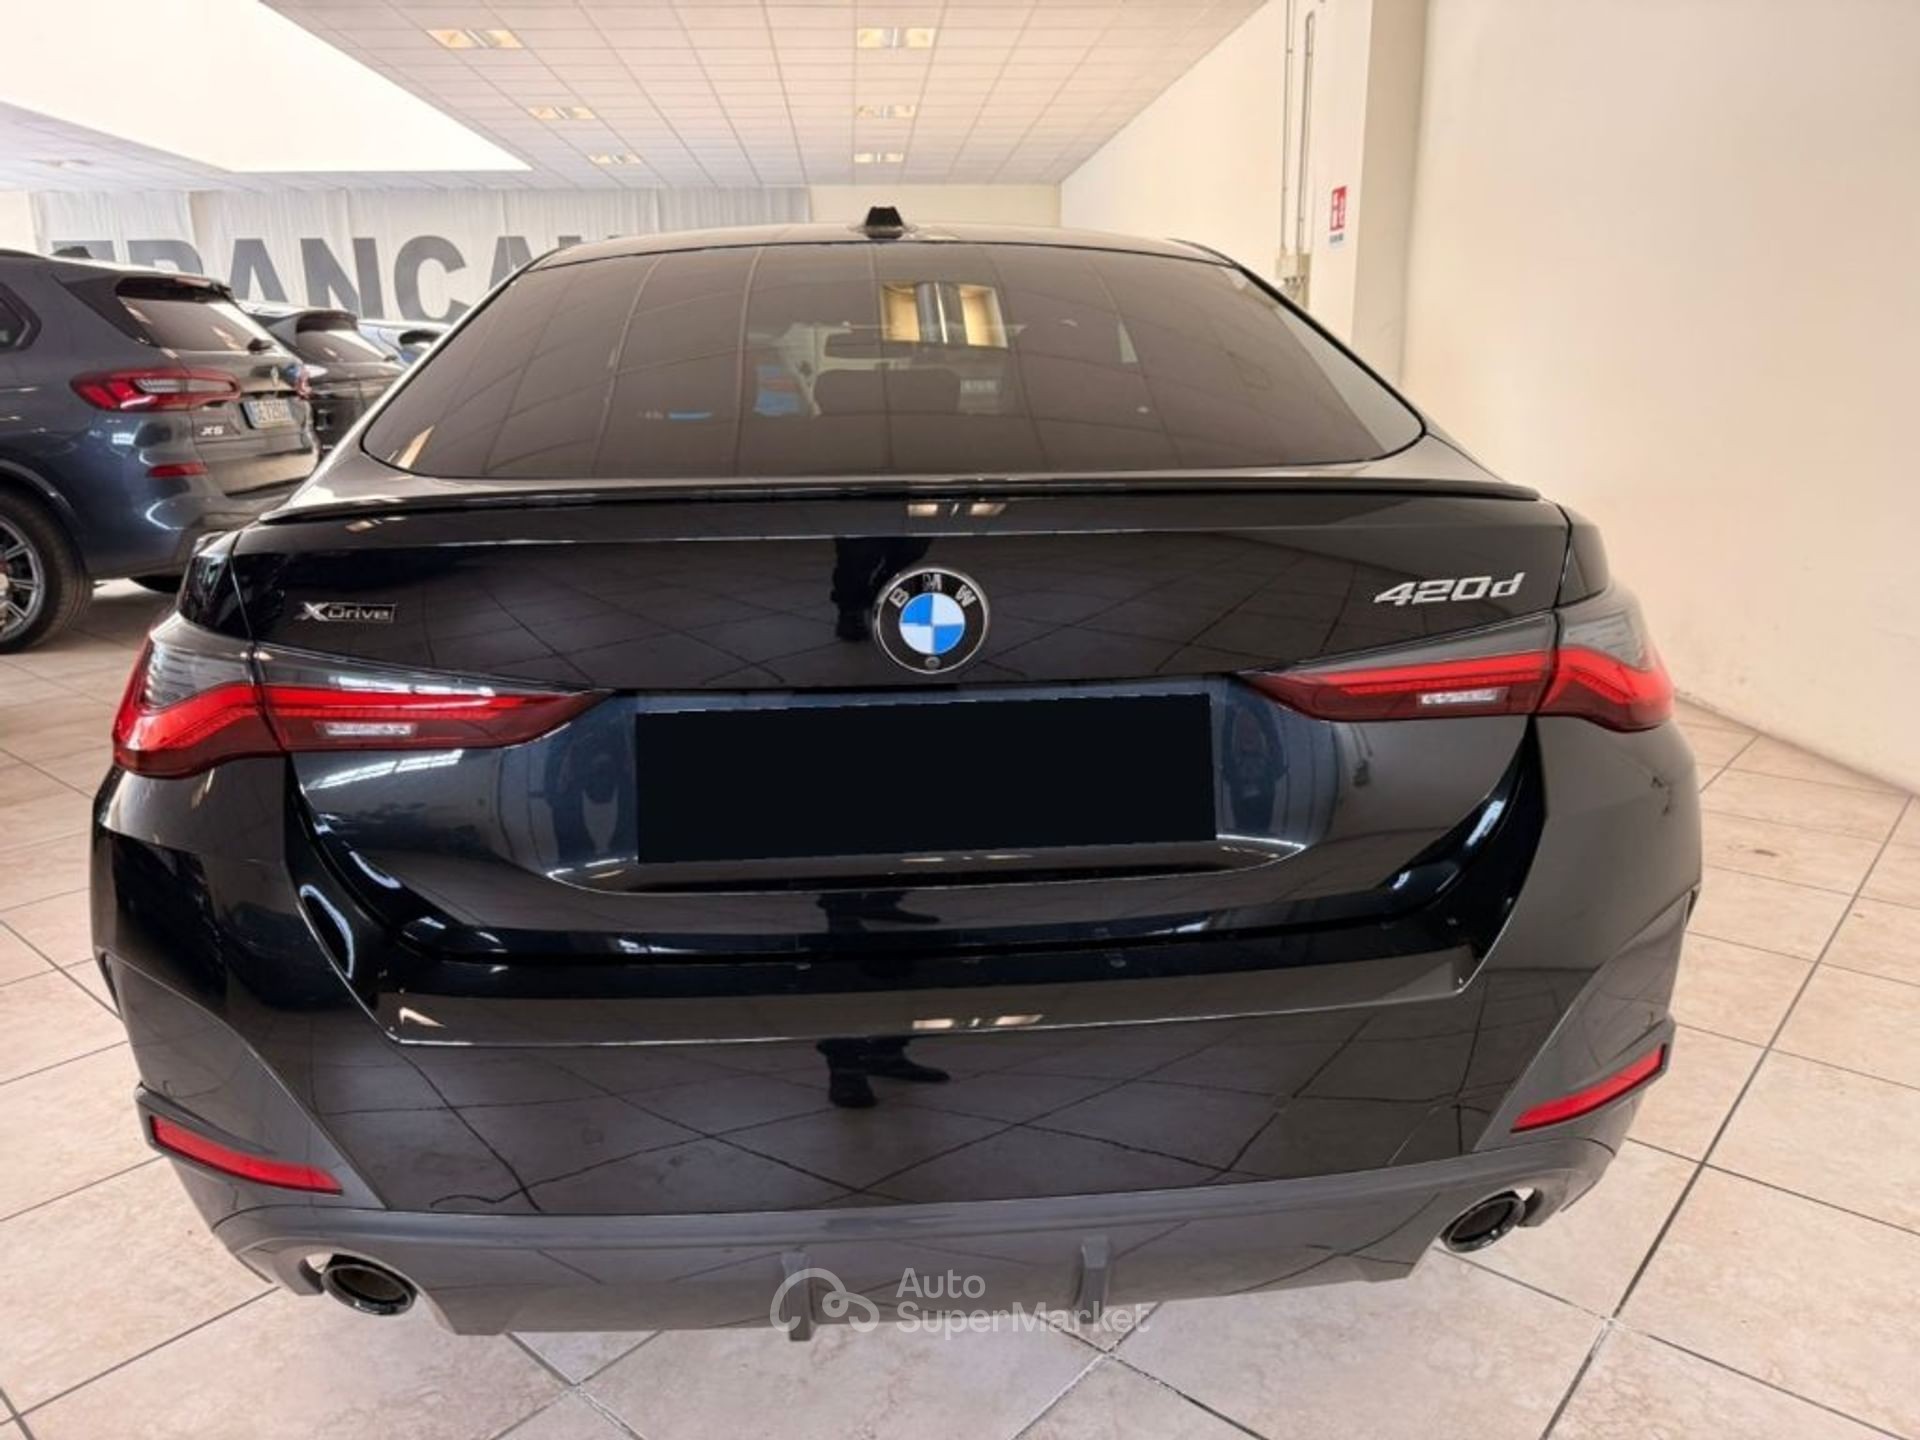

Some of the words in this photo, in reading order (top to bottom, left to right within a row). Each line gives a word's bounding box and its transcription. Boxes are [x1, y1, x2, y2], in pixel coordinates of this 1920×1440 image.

[51, 235, 590, 322] ANCA
[889, 573, 977, 608] BMW
[1373, 572, 1526, 606] 420d
